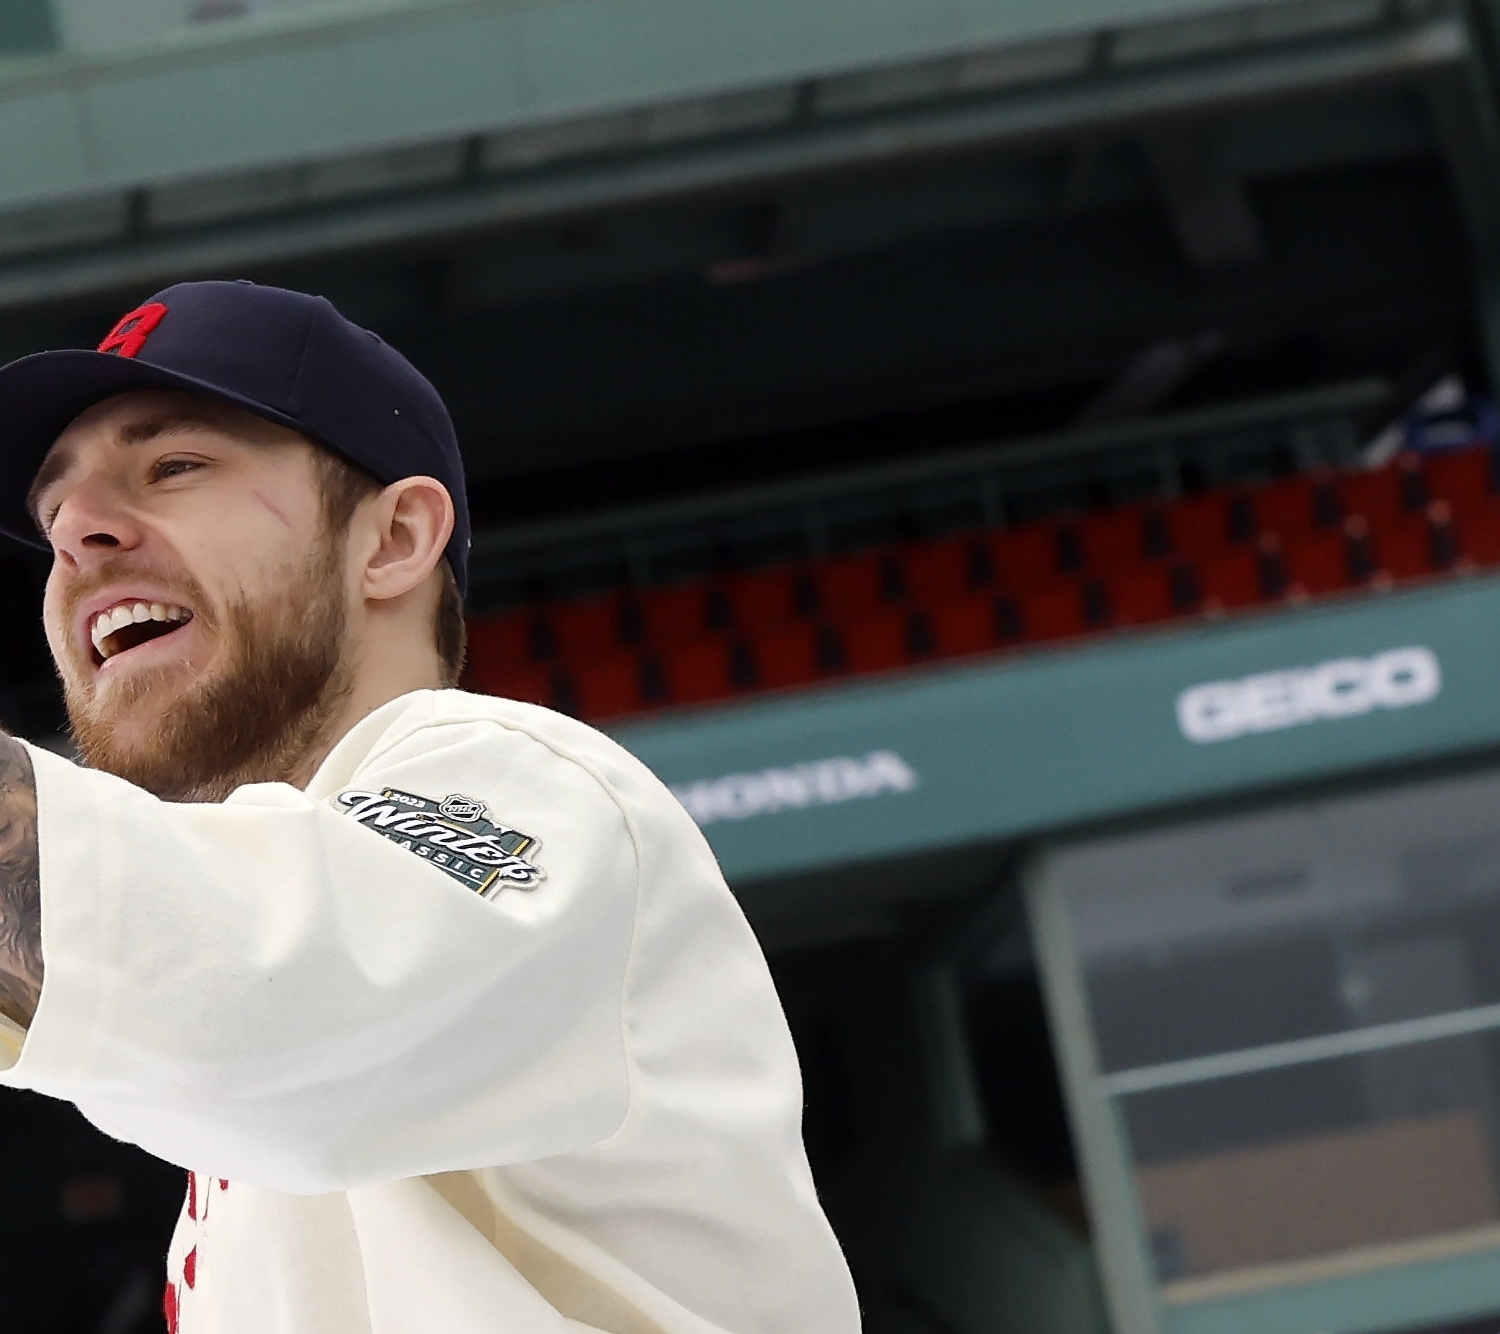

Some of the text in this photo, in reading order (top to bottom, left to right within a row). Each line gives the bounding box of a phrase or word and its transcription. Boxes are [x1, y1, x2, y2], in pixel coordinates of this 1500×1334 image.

[1176, 645, 1441, 743] GEICO
[390, 793, 427, 809] 2023
[448, 804, 477, 814] NHL
[340, 791, 535, 880] Winter
